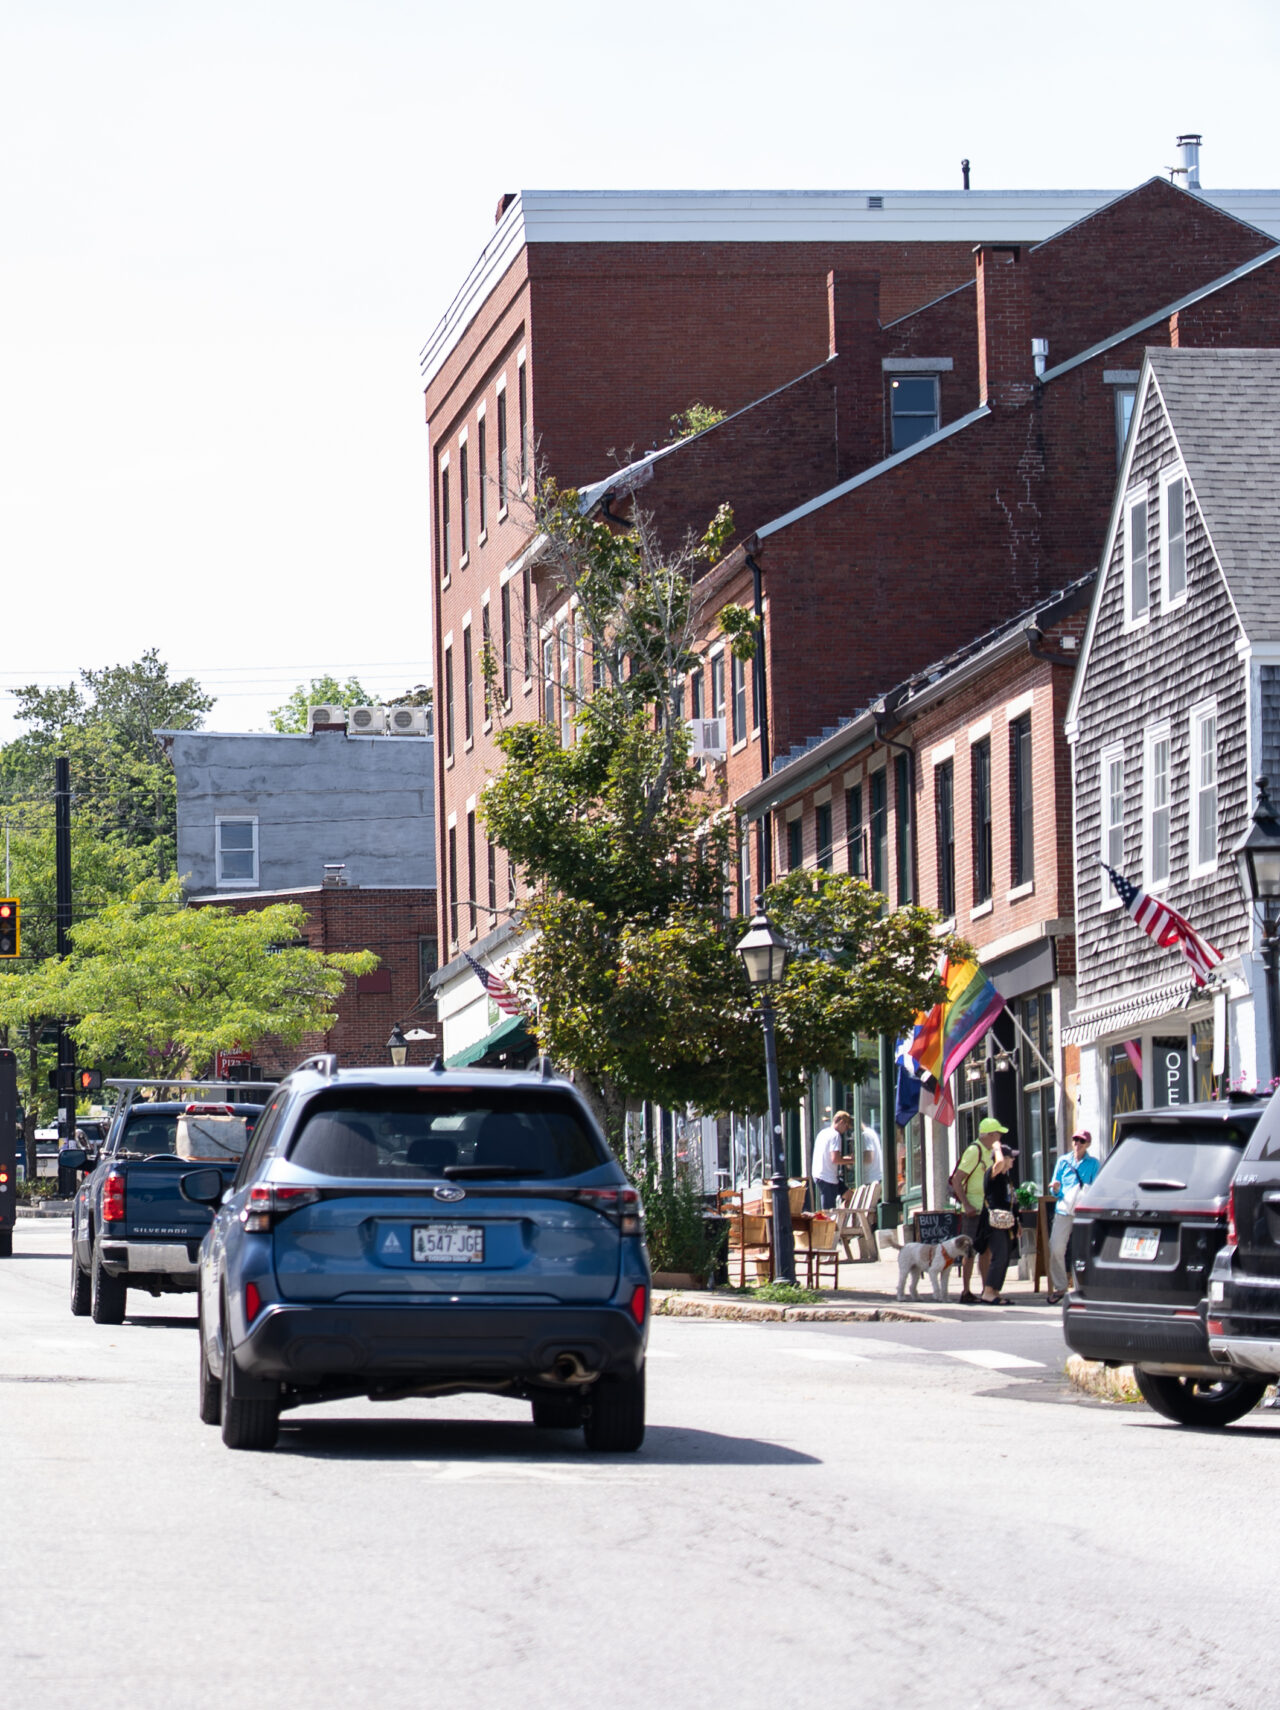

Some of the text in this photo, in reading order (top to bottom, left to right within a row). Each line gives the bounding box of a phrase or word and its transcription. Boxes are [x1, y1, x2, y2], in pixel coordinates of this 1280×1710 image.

[1166, 1052, 1181, 1106] OPE
[919, 1214, 953, 1228] BUY 3
[921, 1226, 950, 1239] BOOKS
